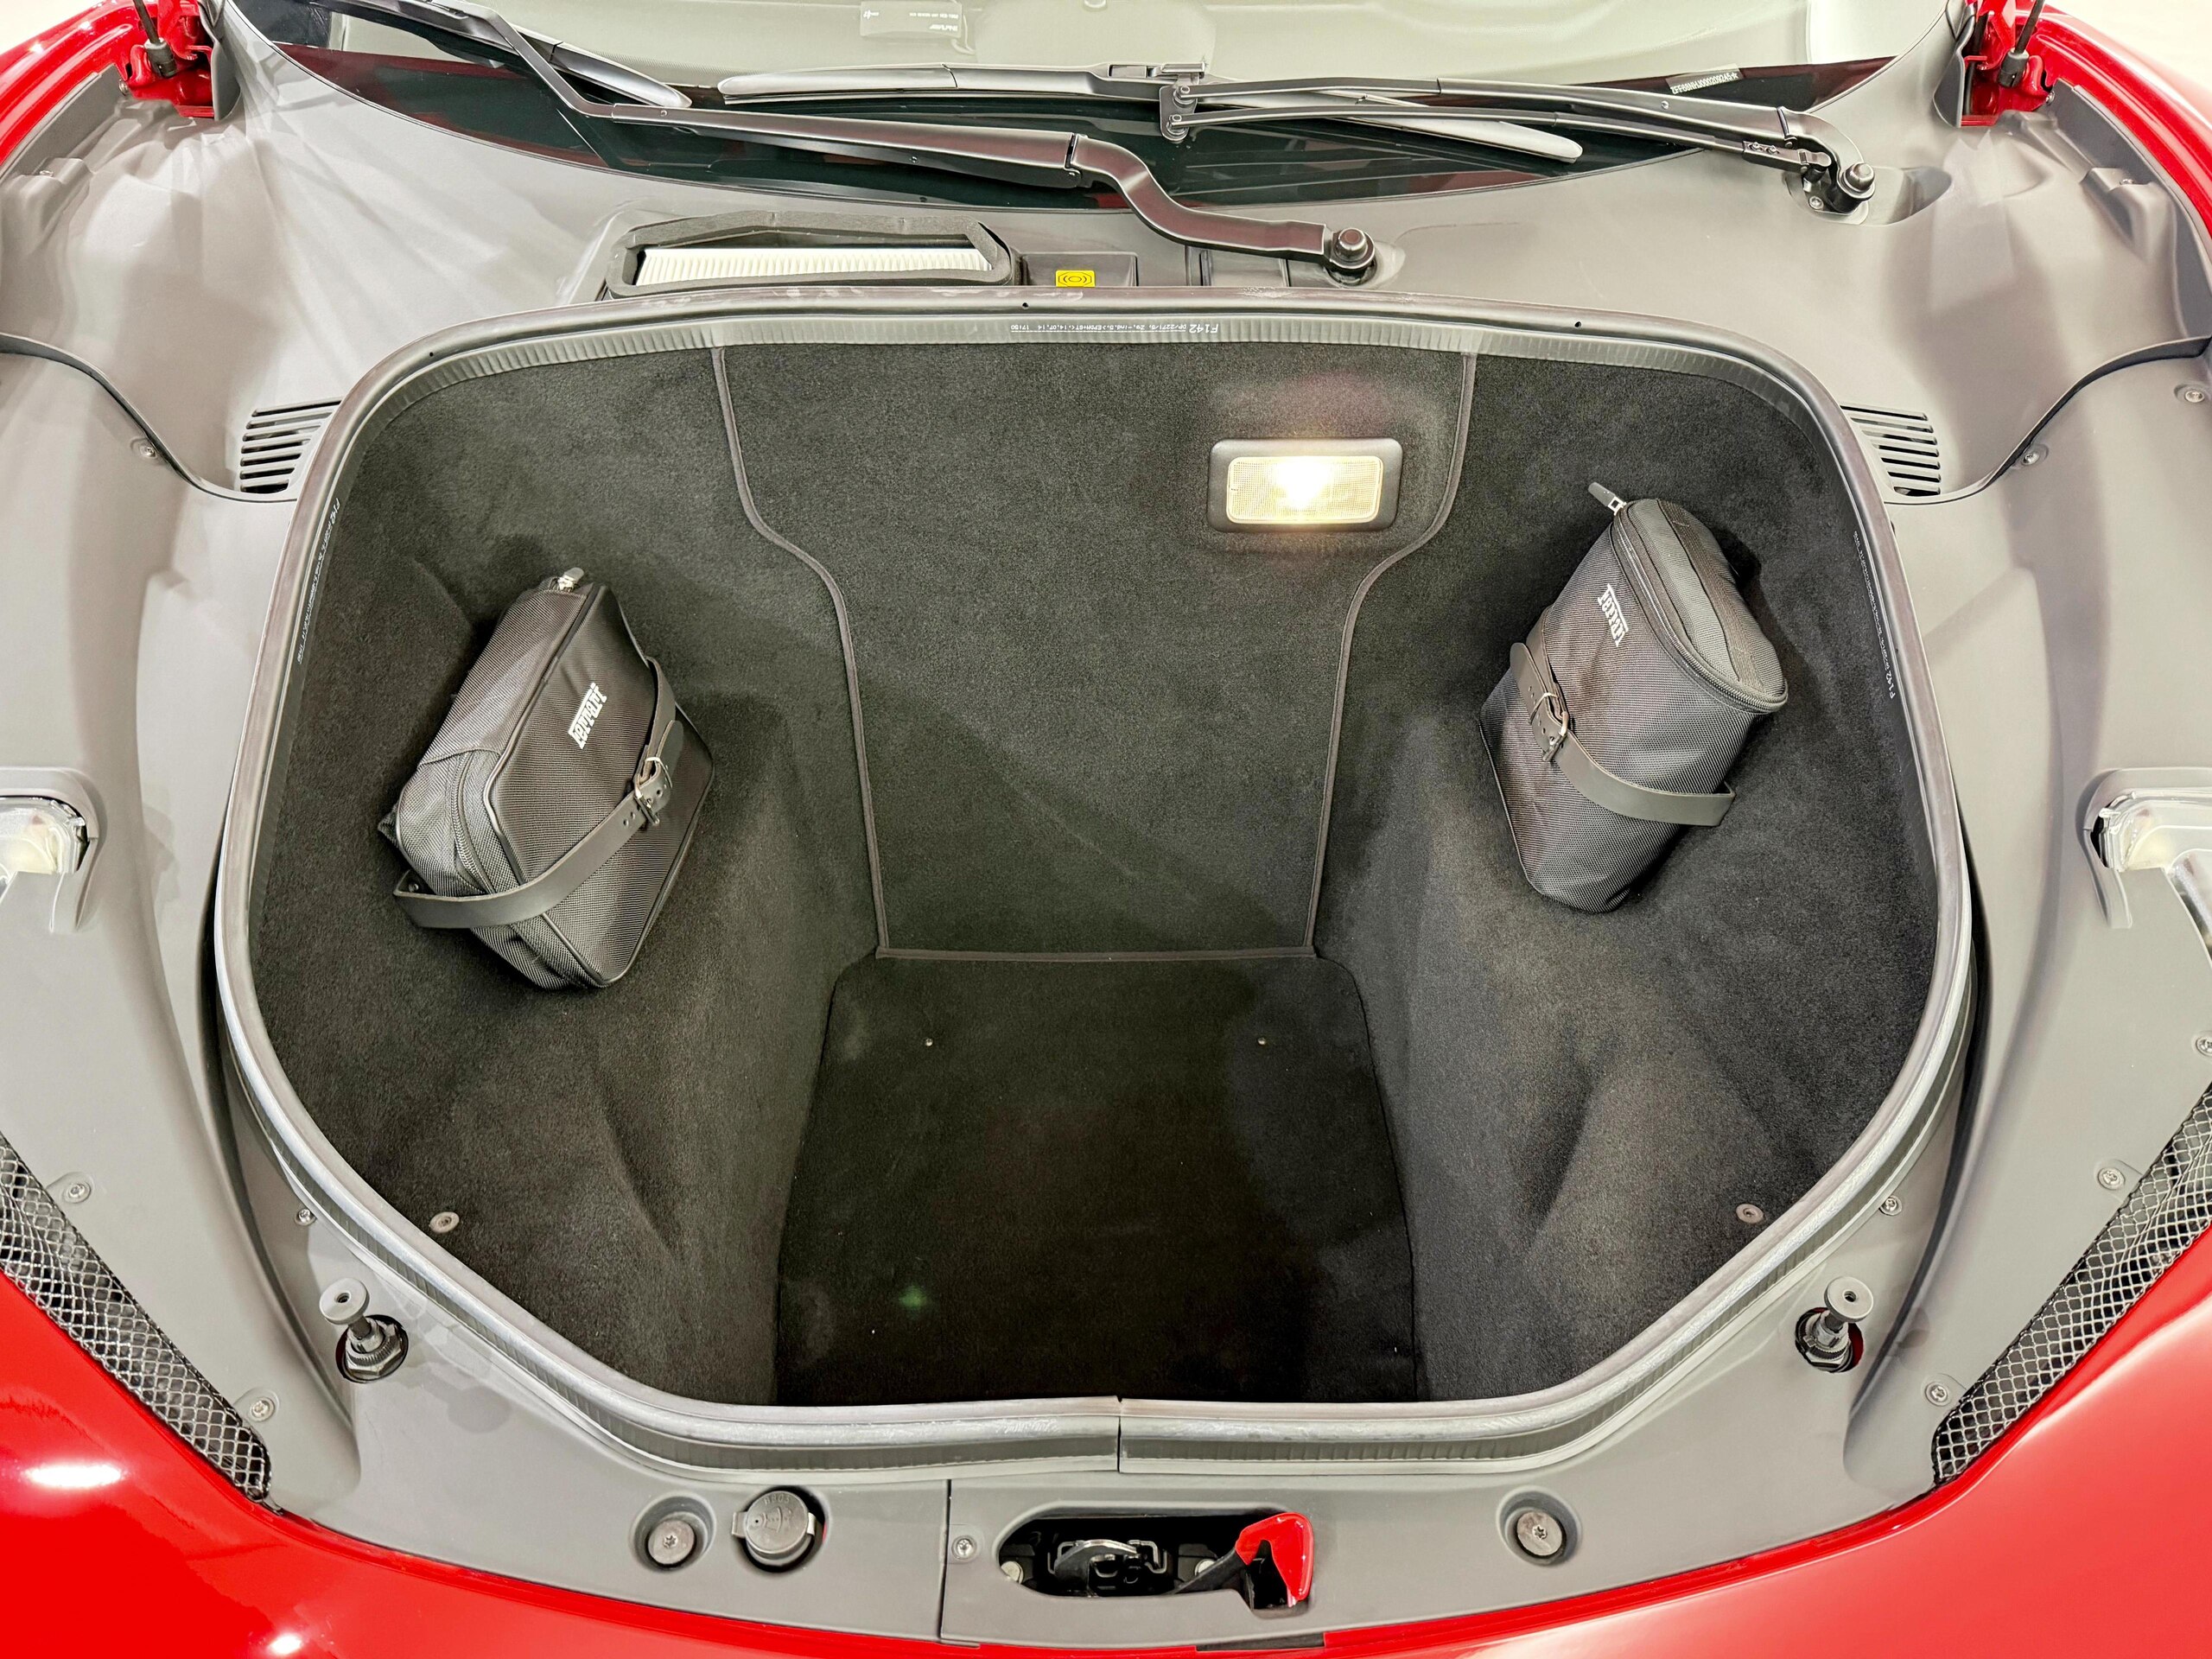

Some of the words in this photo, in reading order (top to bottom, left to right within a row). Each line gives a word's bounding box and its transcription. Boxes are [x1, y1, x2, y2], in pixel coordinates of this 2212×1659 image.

[1189, 323, 1219, 334] F142
[1598, 582, 1629, 647] Ferrari
[1886, 671, 1896, 699] F142
[568, 682, 607, 750] Ferrari
